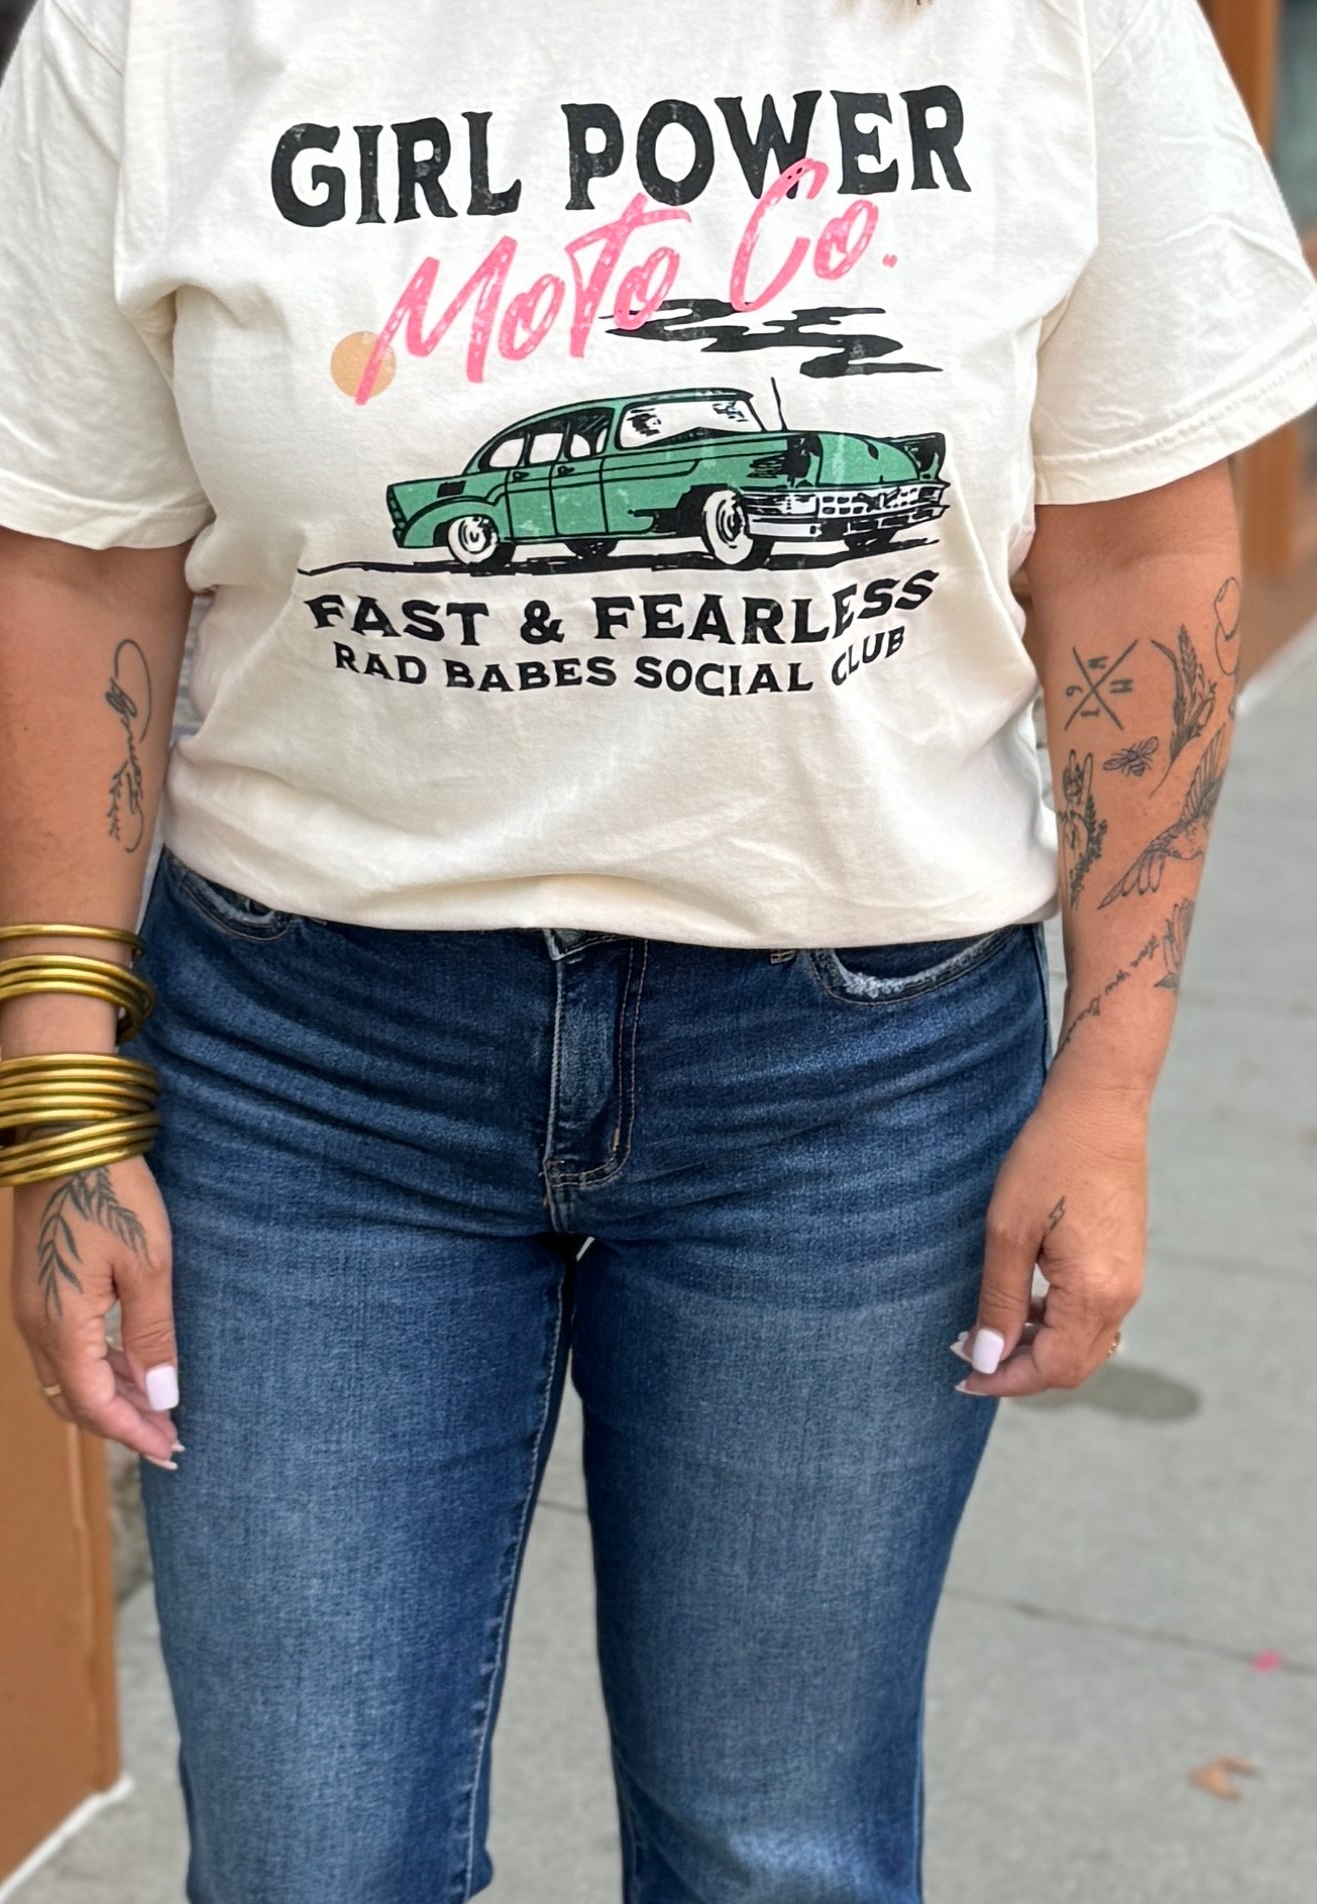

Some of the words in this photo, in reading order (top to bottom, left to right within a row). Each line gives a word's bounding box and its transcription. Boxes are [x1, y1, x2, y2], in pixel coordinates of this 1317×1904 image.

[271, 110, 522, 227] GIRL
[561, 84, 972, 211] POWER
[729, 157, 898, 312] Co.
[304, 592, 488, 647] FAST
[520, 599, 565, 645] &
[593, 568, 941, 646] FEARLESS
[333, 641, 428, 686] RAD
[445, 654, 617, 693] BABES
[633, 656, 814, 696] SOCIAL
[830, 624, 907, 687] CLUB
